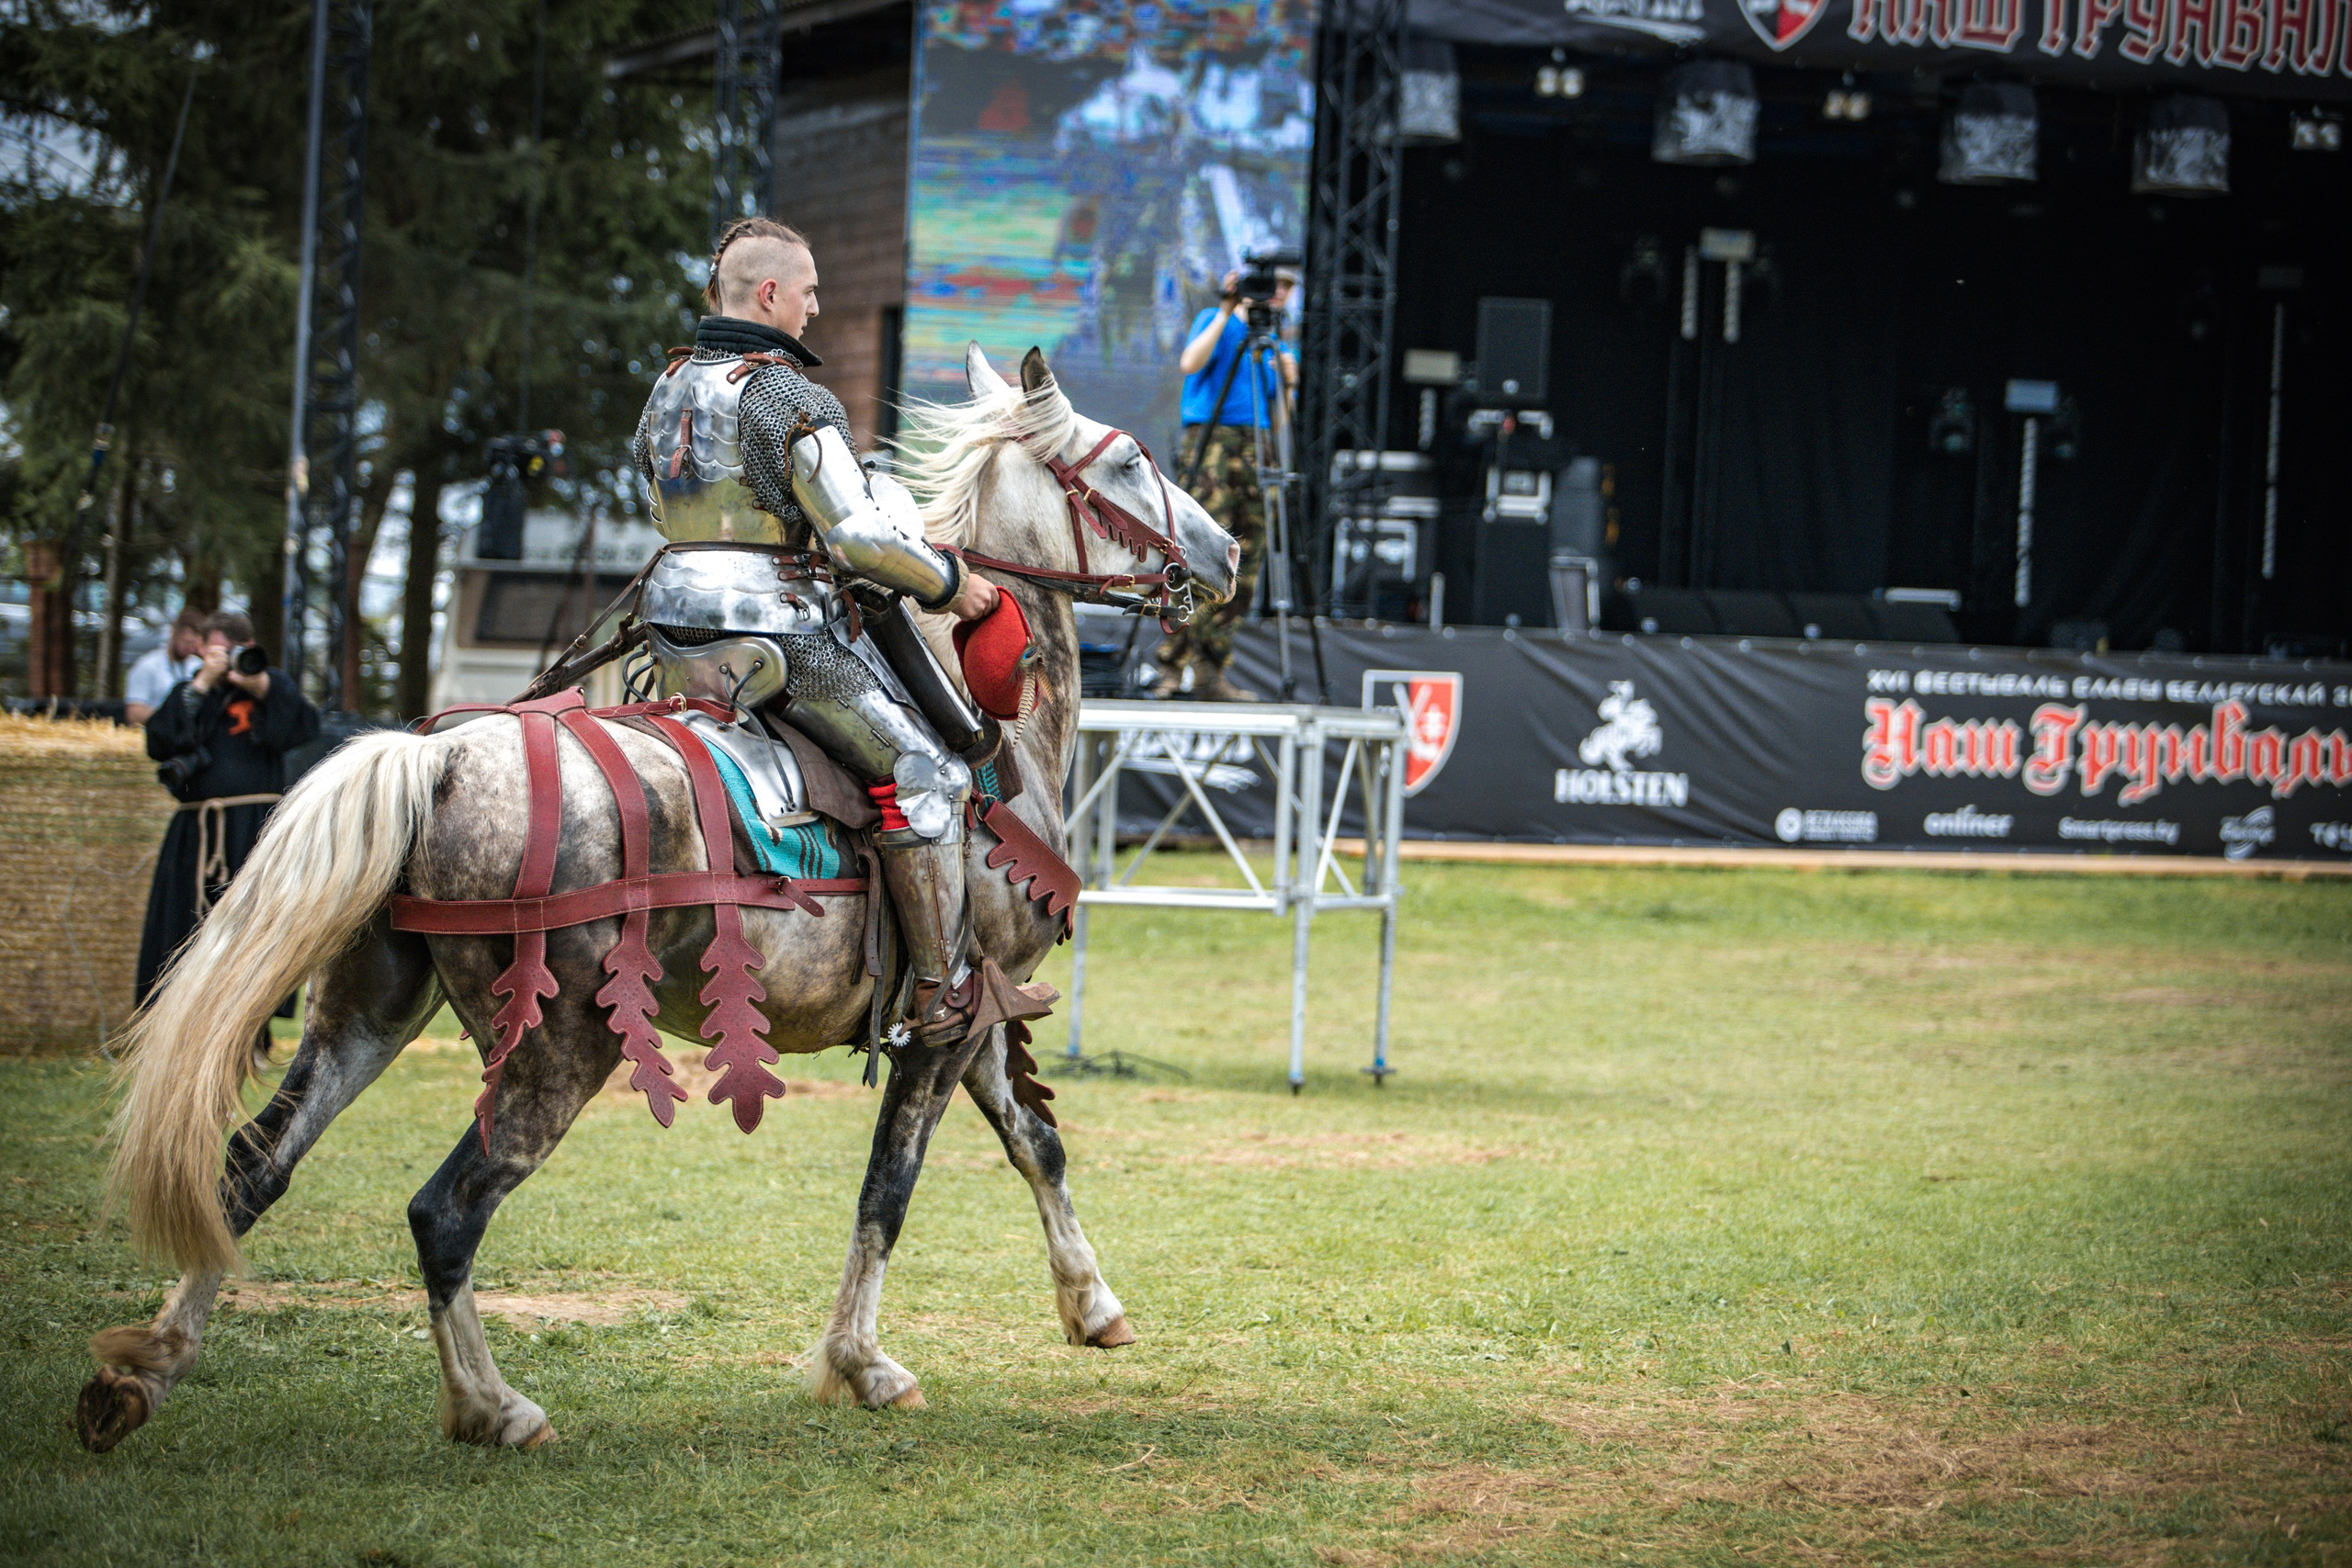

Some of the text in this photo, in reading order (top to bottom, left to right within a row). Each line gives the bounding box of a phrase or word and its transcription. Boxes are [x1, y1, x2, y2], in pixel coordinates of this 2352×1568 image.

[1867, 669, 1910, 693] XVI
[1861, 696, 2023, 790] Наш
[1555, 769, 1688, 807] HOLSTEN
